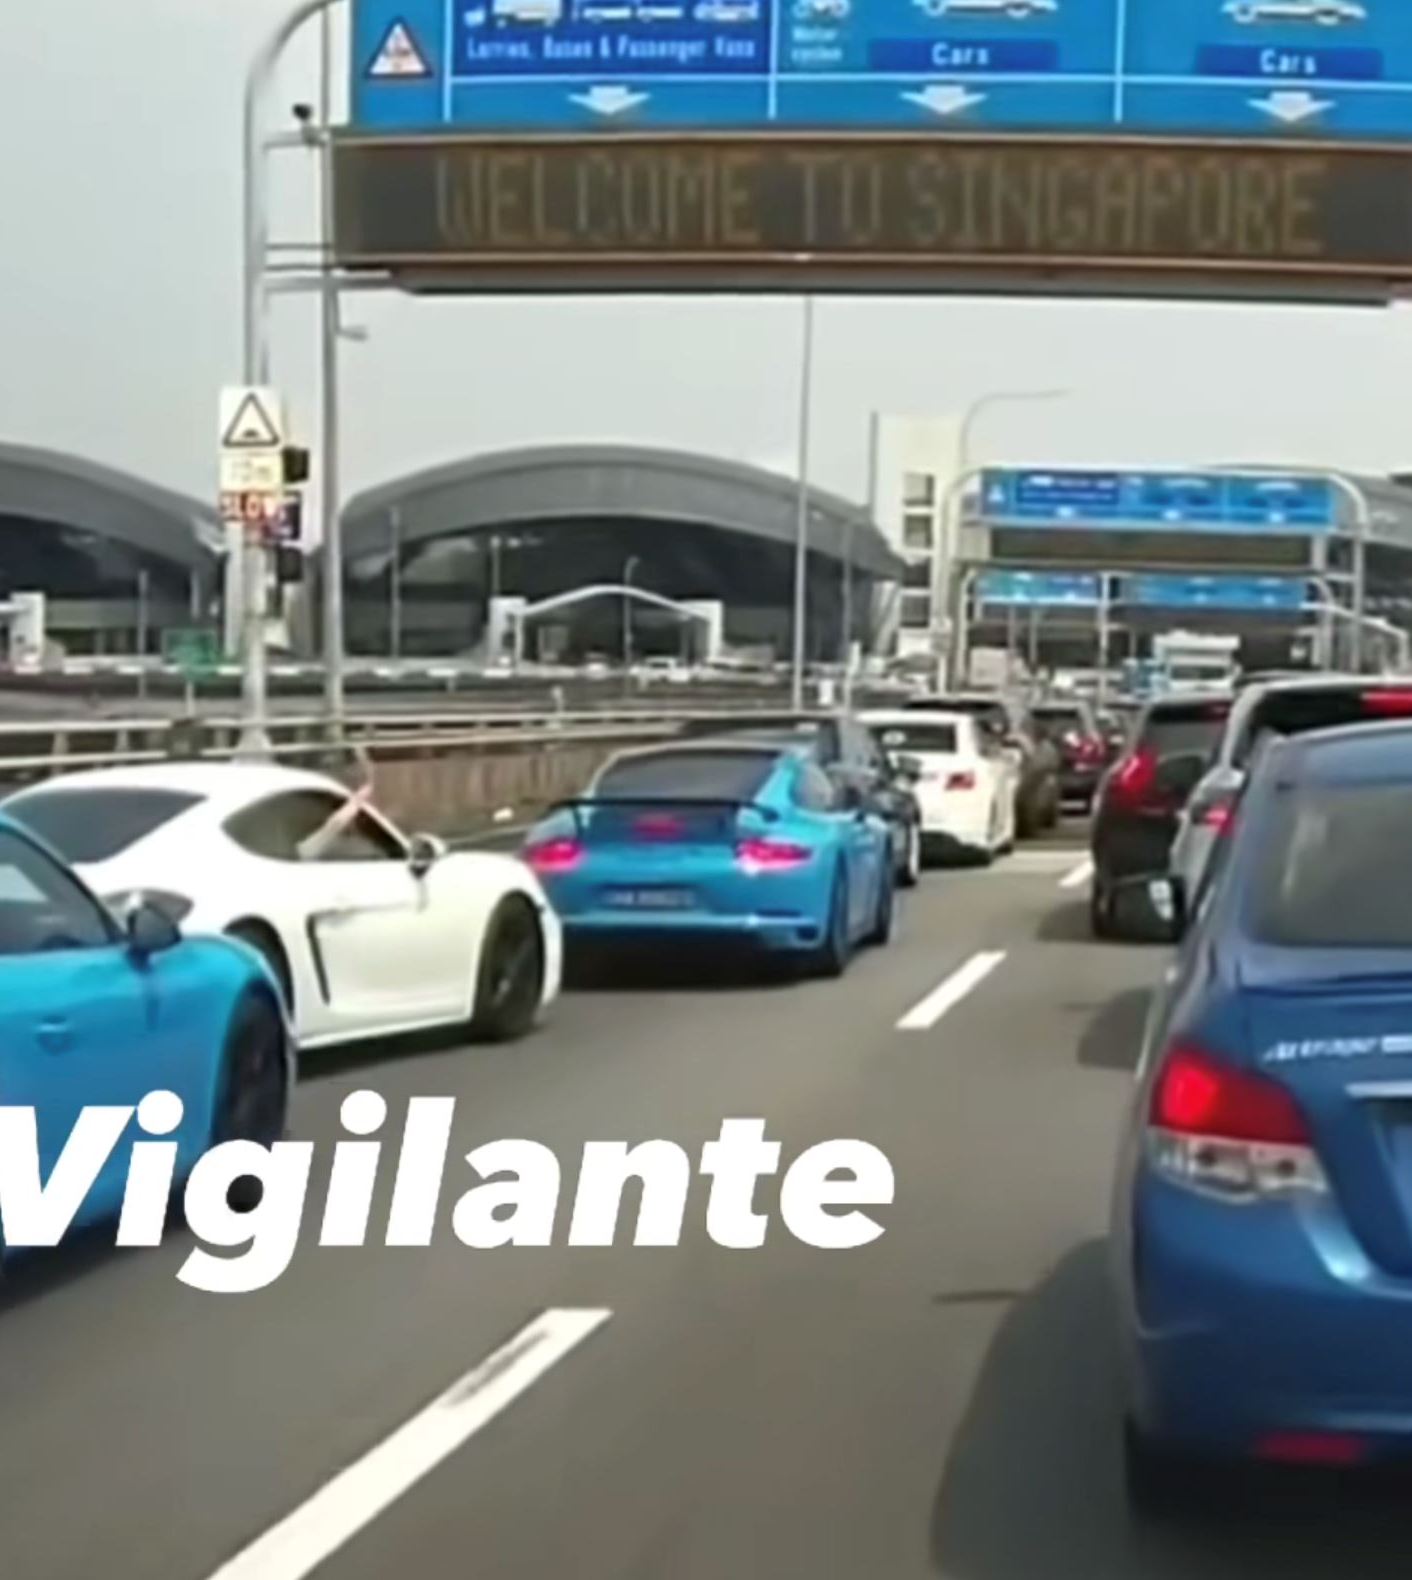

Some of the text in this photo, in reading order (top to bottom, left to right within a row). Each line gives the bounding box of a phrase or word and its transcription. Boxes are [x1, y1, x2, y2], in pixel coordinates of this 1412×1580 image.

[931, 43, 990, 66] Cars
[1260, 50, 1317, 75] Cars
[437, 151, 1329, 254] WELCOME TO SINGAPORE
